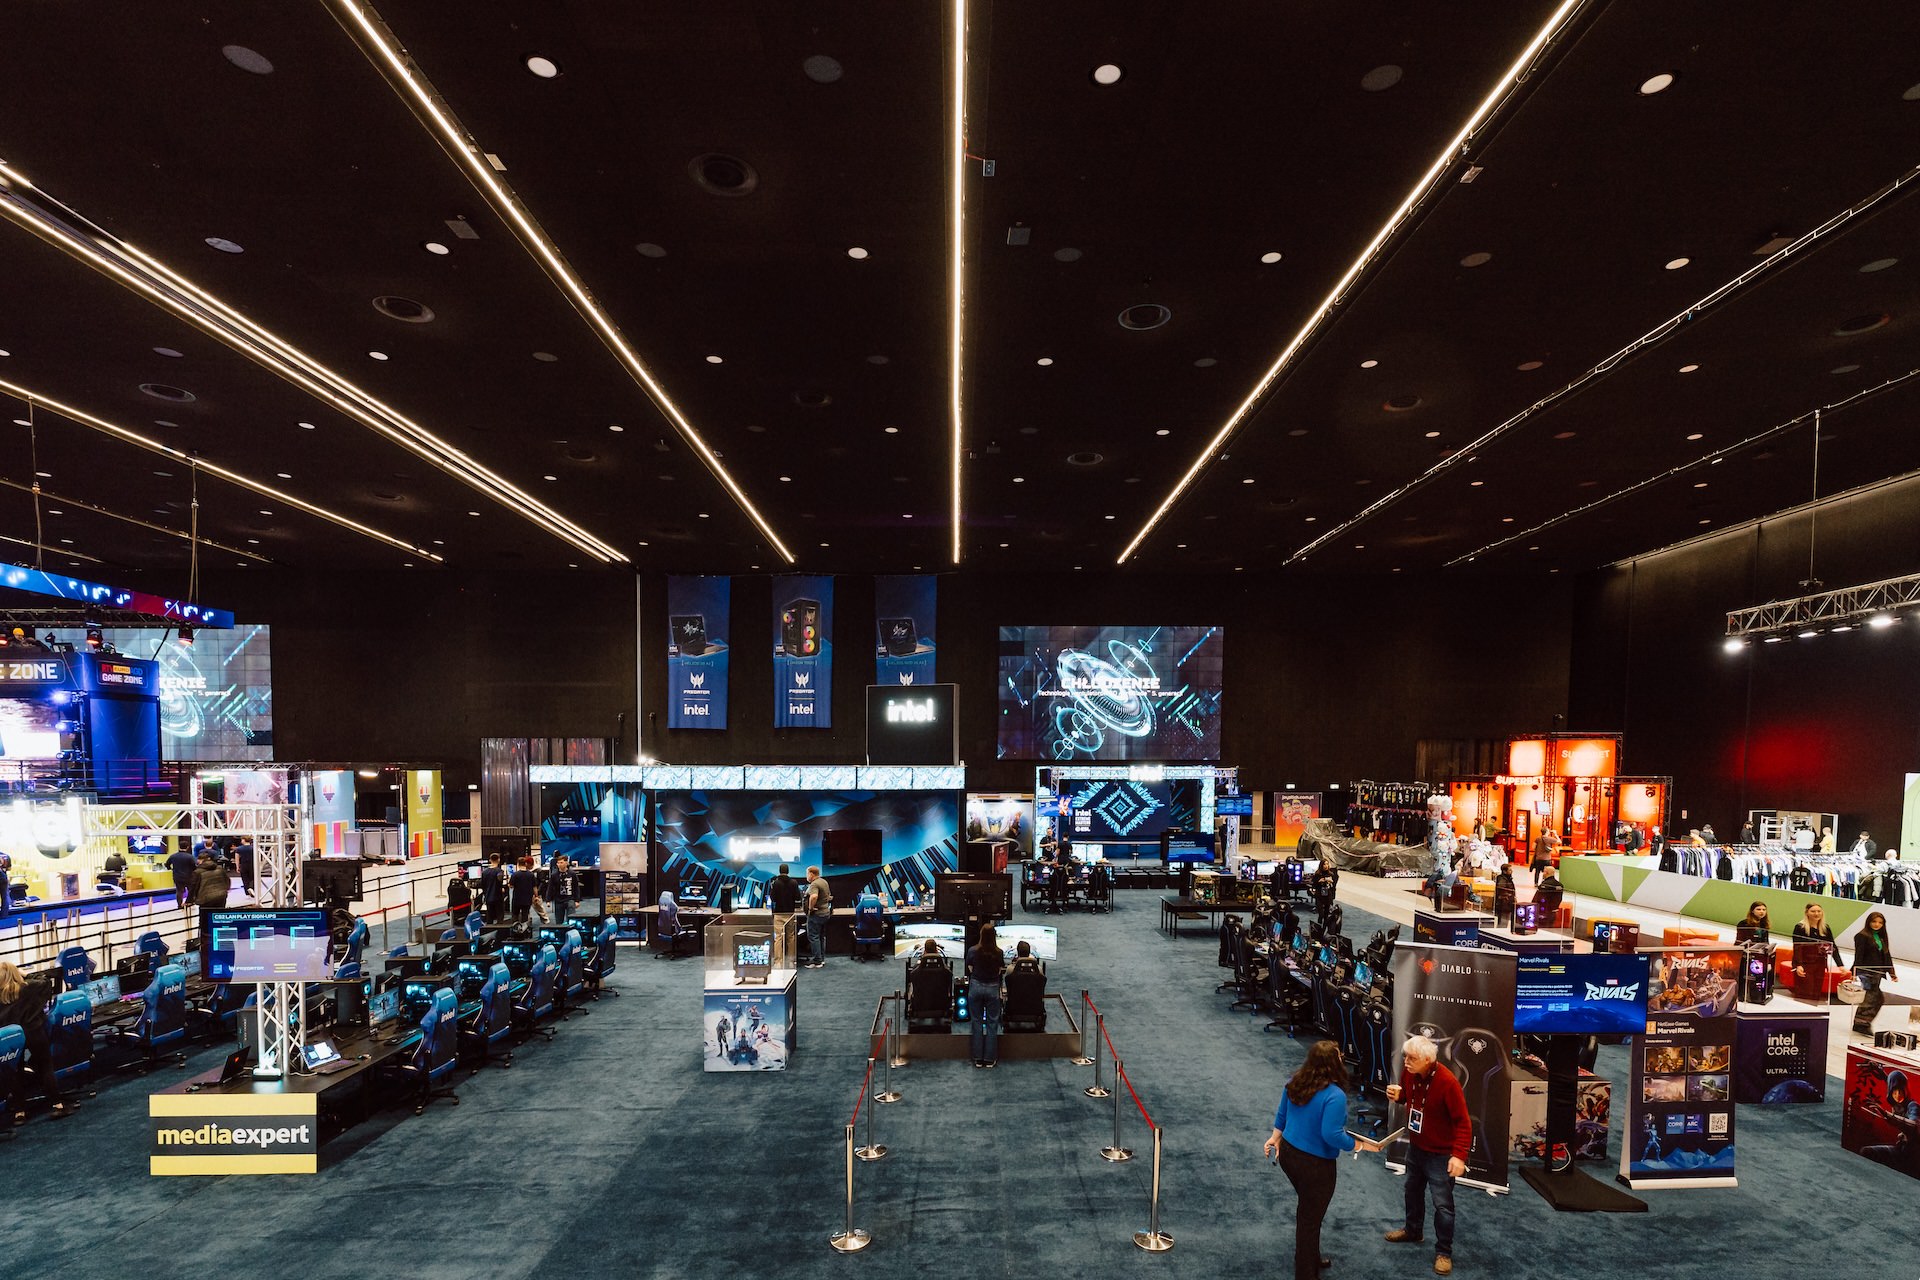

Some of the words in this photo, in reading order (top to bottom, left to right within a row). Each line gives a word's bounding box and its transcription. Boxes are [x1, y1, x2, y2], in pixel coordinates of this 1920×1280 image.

[9, 663, 58, 680] ZONE
[102, 673, 123, 683] GAME
[124, 674, 143, 685] ZONE
[1495, 775, 1544, 785] SUPERBET
[545, 963, 556, 973] intel
[1441, 963, 1472, 975] DIABLO
[1670, 955, 1710, 970] RIVALS
[67, 966, 84, 977] intel
[163, 982, 182, 995] intel
[497, 981, 509, 993] intel
[1584, 981, 1640, 1001] RIVALS
[1469, 999, 1492, 1008] DETAILS
[62, 1010, 86, 1026] intel
[441, 1008, 455, 1022] intel
[1767, 1033, 1795, 1046] intel
[0, 1048, 19, 1063] ntel
[157, 1122, 310, 1148] mediaexpert
